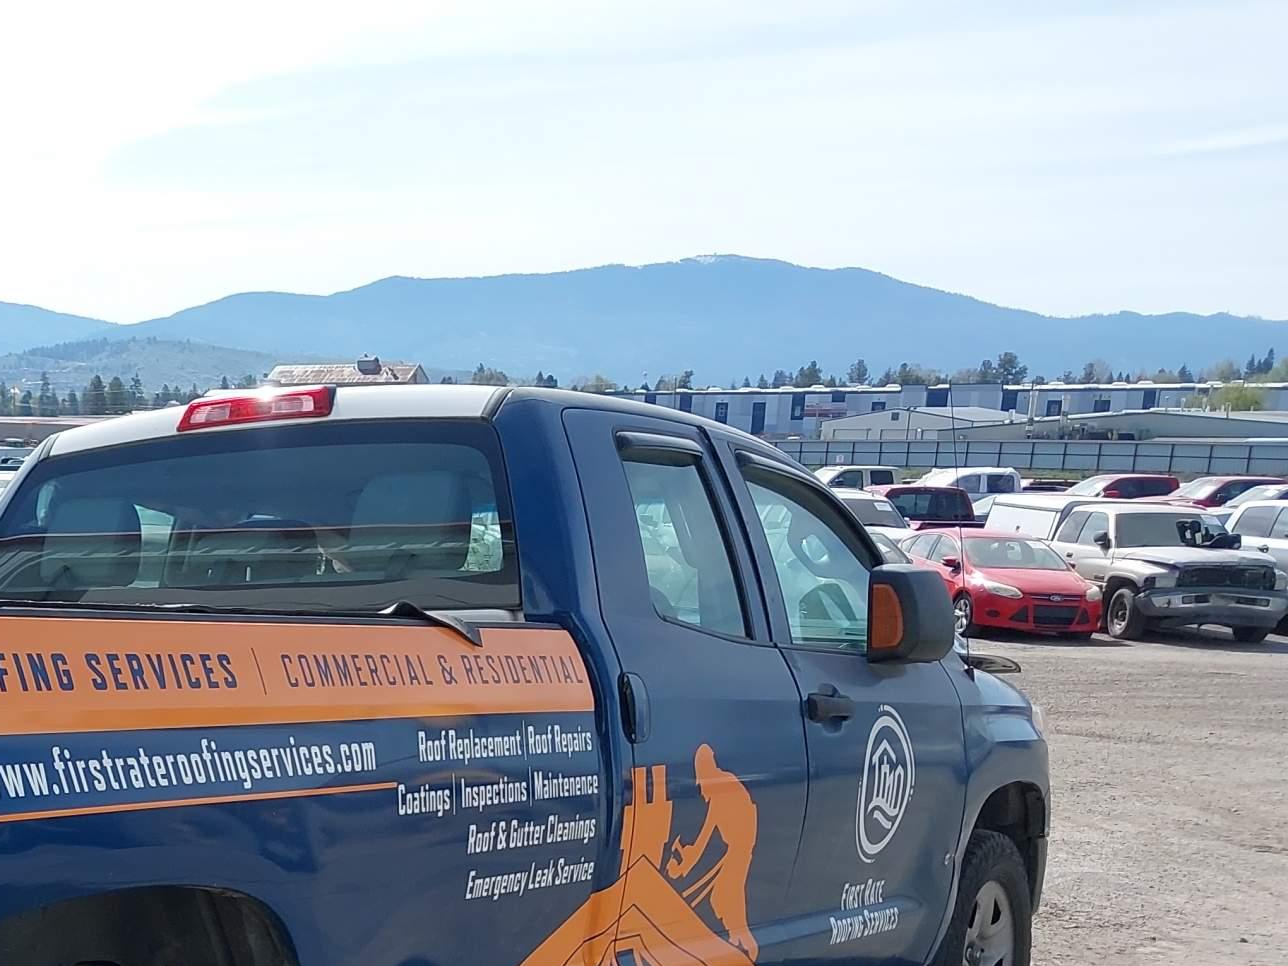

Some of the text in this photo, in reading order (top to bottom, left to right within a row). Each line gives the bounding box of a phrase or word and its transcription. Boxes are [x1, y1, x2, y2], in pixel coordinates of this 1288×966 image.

[85, 652, 239, 690] SERVICES
[280, 653, 434, 688] COMMERCIAL
[440, 653, 458, 684] &
[463, 654, 584, 685] RESIDENTIAL
[418, 724, 593, 765] Roof Replacement Roof Repairs
[398, 770, 599, 817] Coatings Inspections Maintenence
[467, 814, 596, 854] Roof & Gutter Cleanings
[465, 856, 594, 900] Emergency Leak Service
[840, 878, 886, 911] FIRST RATE
[830, 907, 899, 945] ROOFING SERVICES
